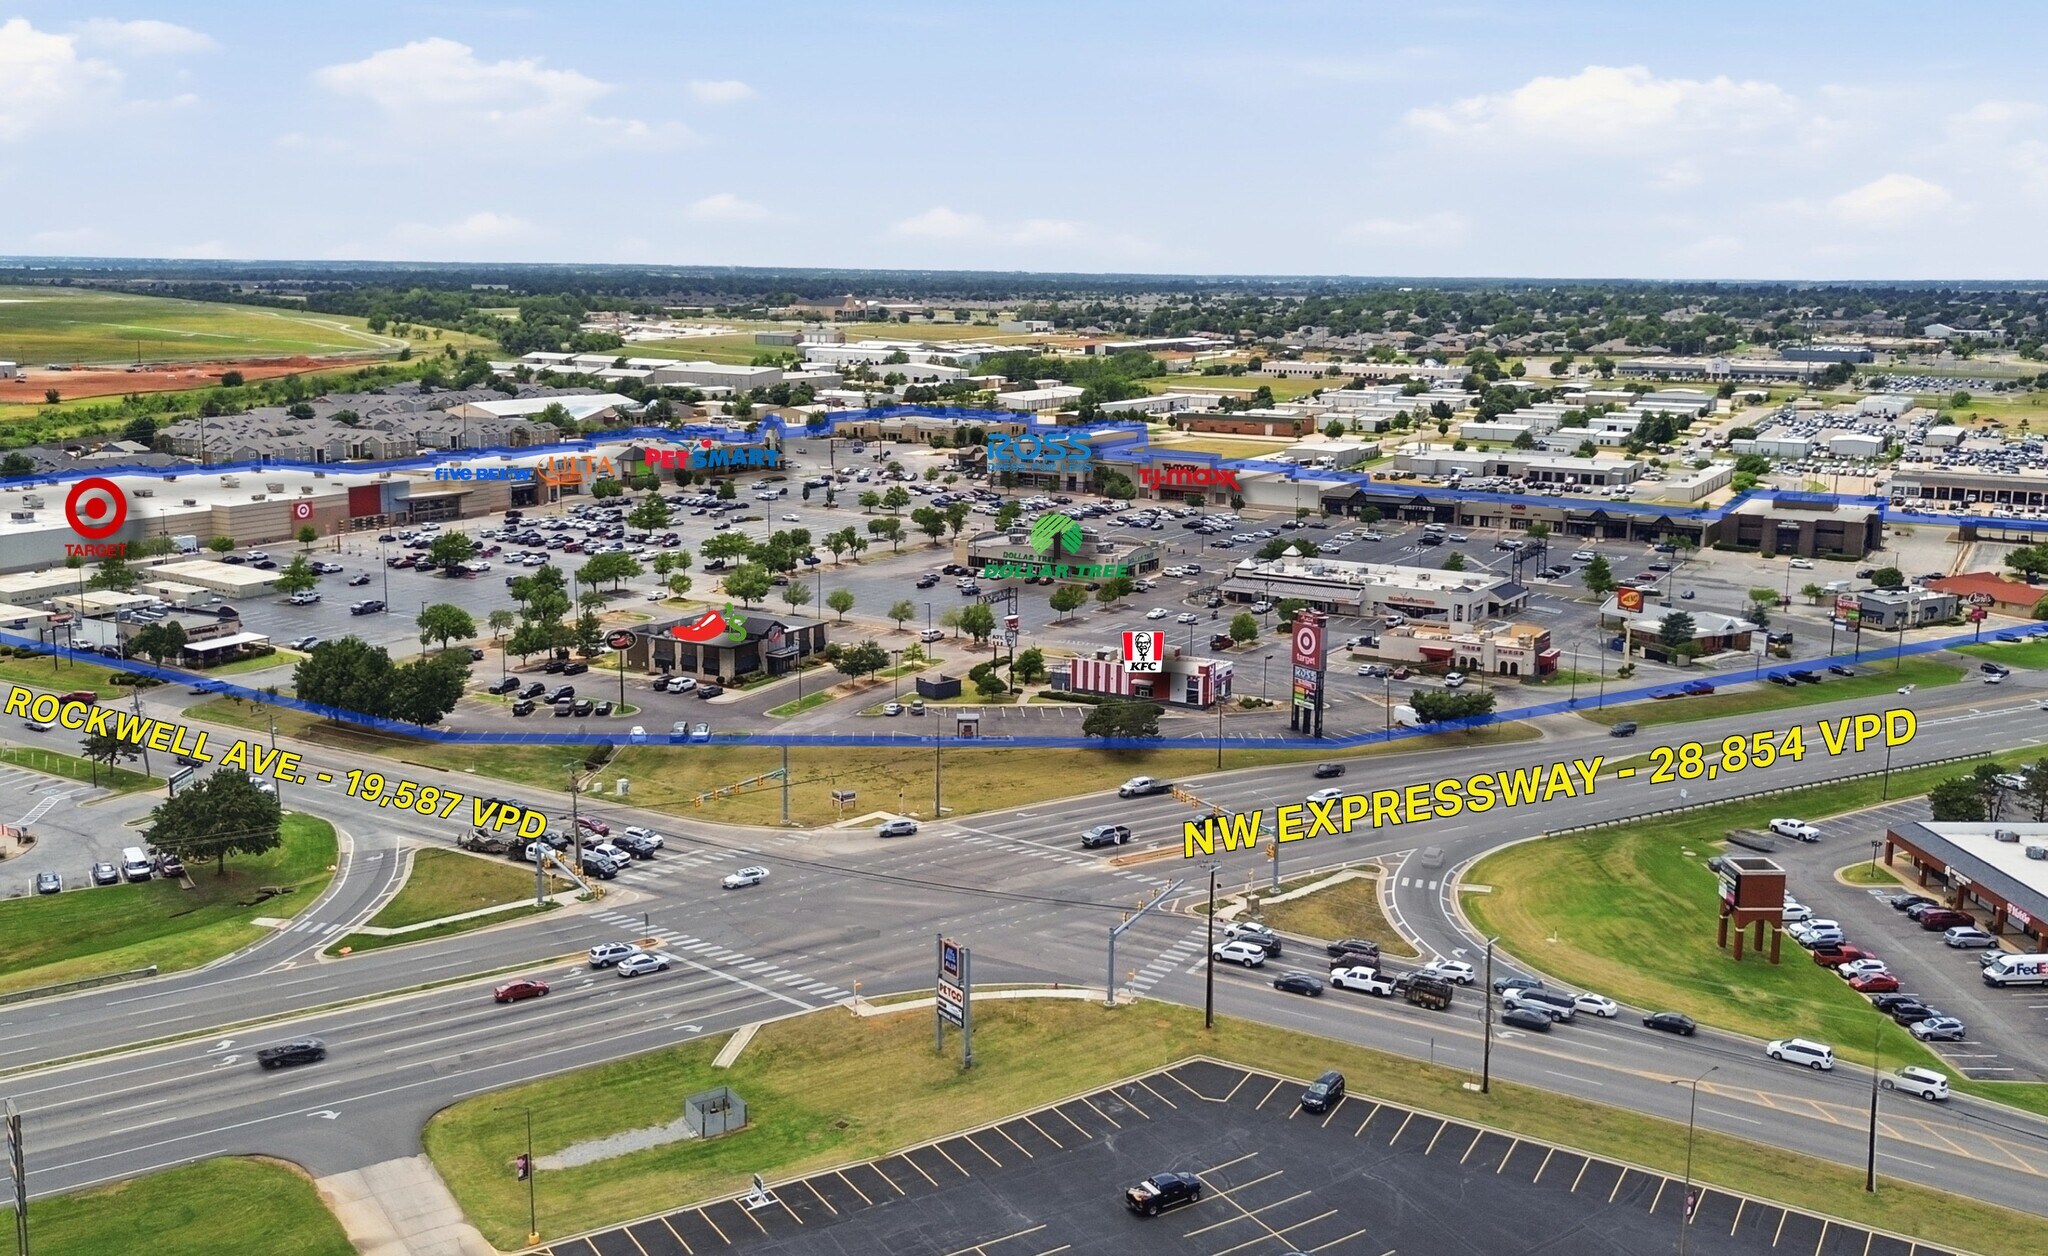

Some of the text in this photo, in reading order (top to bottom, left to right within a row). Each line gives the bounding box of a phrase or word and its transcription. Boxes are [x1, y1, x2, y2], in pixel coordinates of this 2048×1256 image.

[1296, 653, 1316, 665] target
[2016, 963, 2048, 976] FedE
[939, 982, 963, 1003] PETCO
